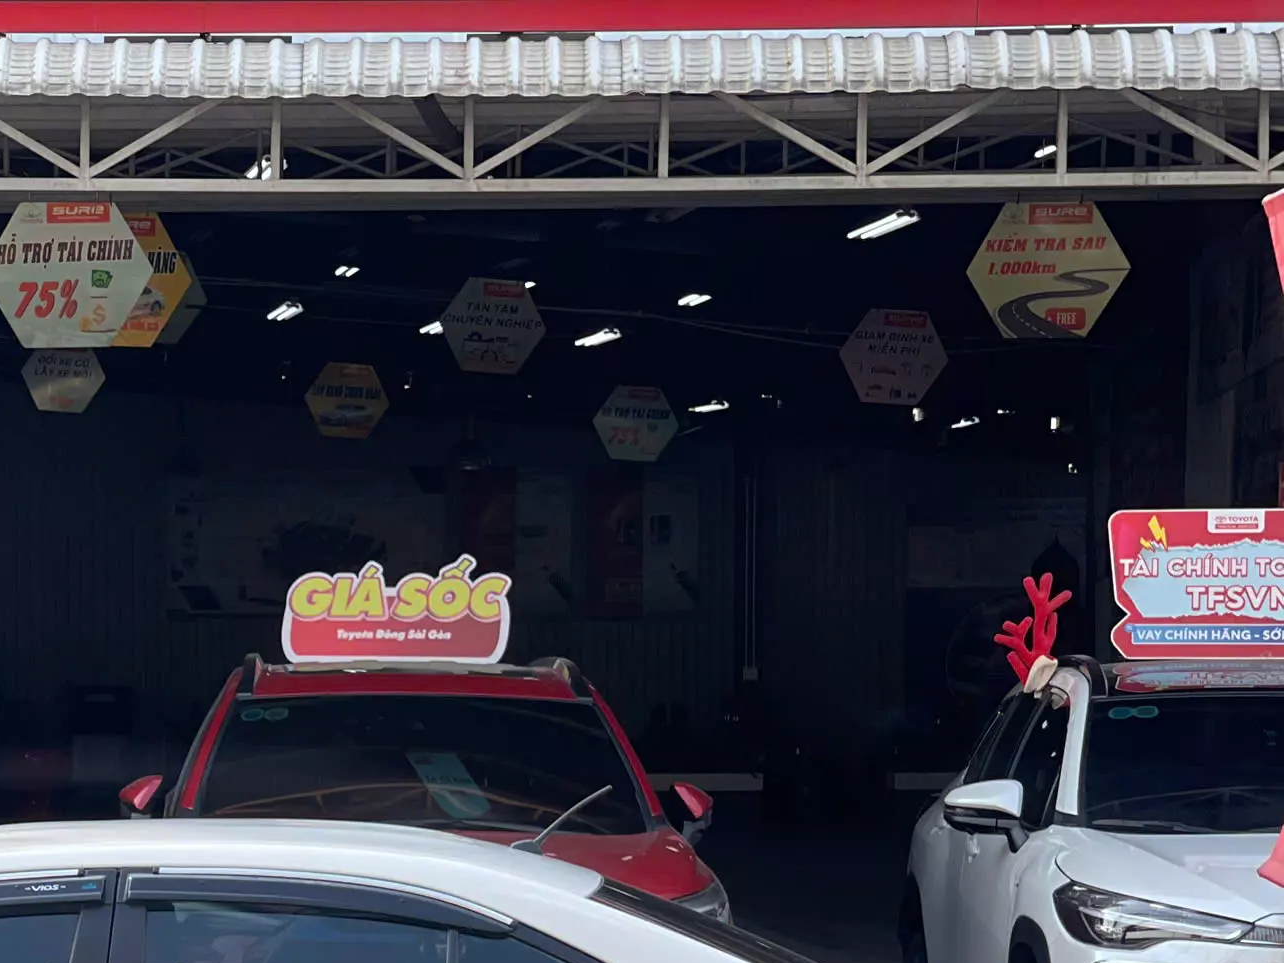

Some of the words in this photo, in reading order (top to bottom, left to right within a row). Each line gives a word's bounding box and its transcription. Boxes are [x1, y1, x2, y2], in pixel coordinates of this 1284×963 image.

[51, 205, 105, 216] SURE
[1034, 207, 1090, 217] SURE
[128, 220, 152, 231] RE
[1033, 236, 1067, 253] TRA
[1072, 235, 1108, 251] SAU
[22, 238, 54, 269] TRỢ
[57, 235, 84, 263] TÀI
[87, 235, 134, 262] CHÍNH
[987, 260, 1057, 276] 1.000km
[14, 279, 79, 319] 75%
[1056, 311, 1077, 326] FREE
[1119, 553, 1159, 578] TÀI
[1167, 553, 1248, 578] CHÍNH
[289, 563, 386, 619] GIÁ
[391, 556, 509, 621] SỐC
[336, 628, 374, 641] Toyota
[1137, 630, 1162, 641] VAY
[1165, 626, 1208, 641] CHÍNH
[1211, 628, 1251, 641] HÃNG
[31, 884, 59, 892] VIOS
